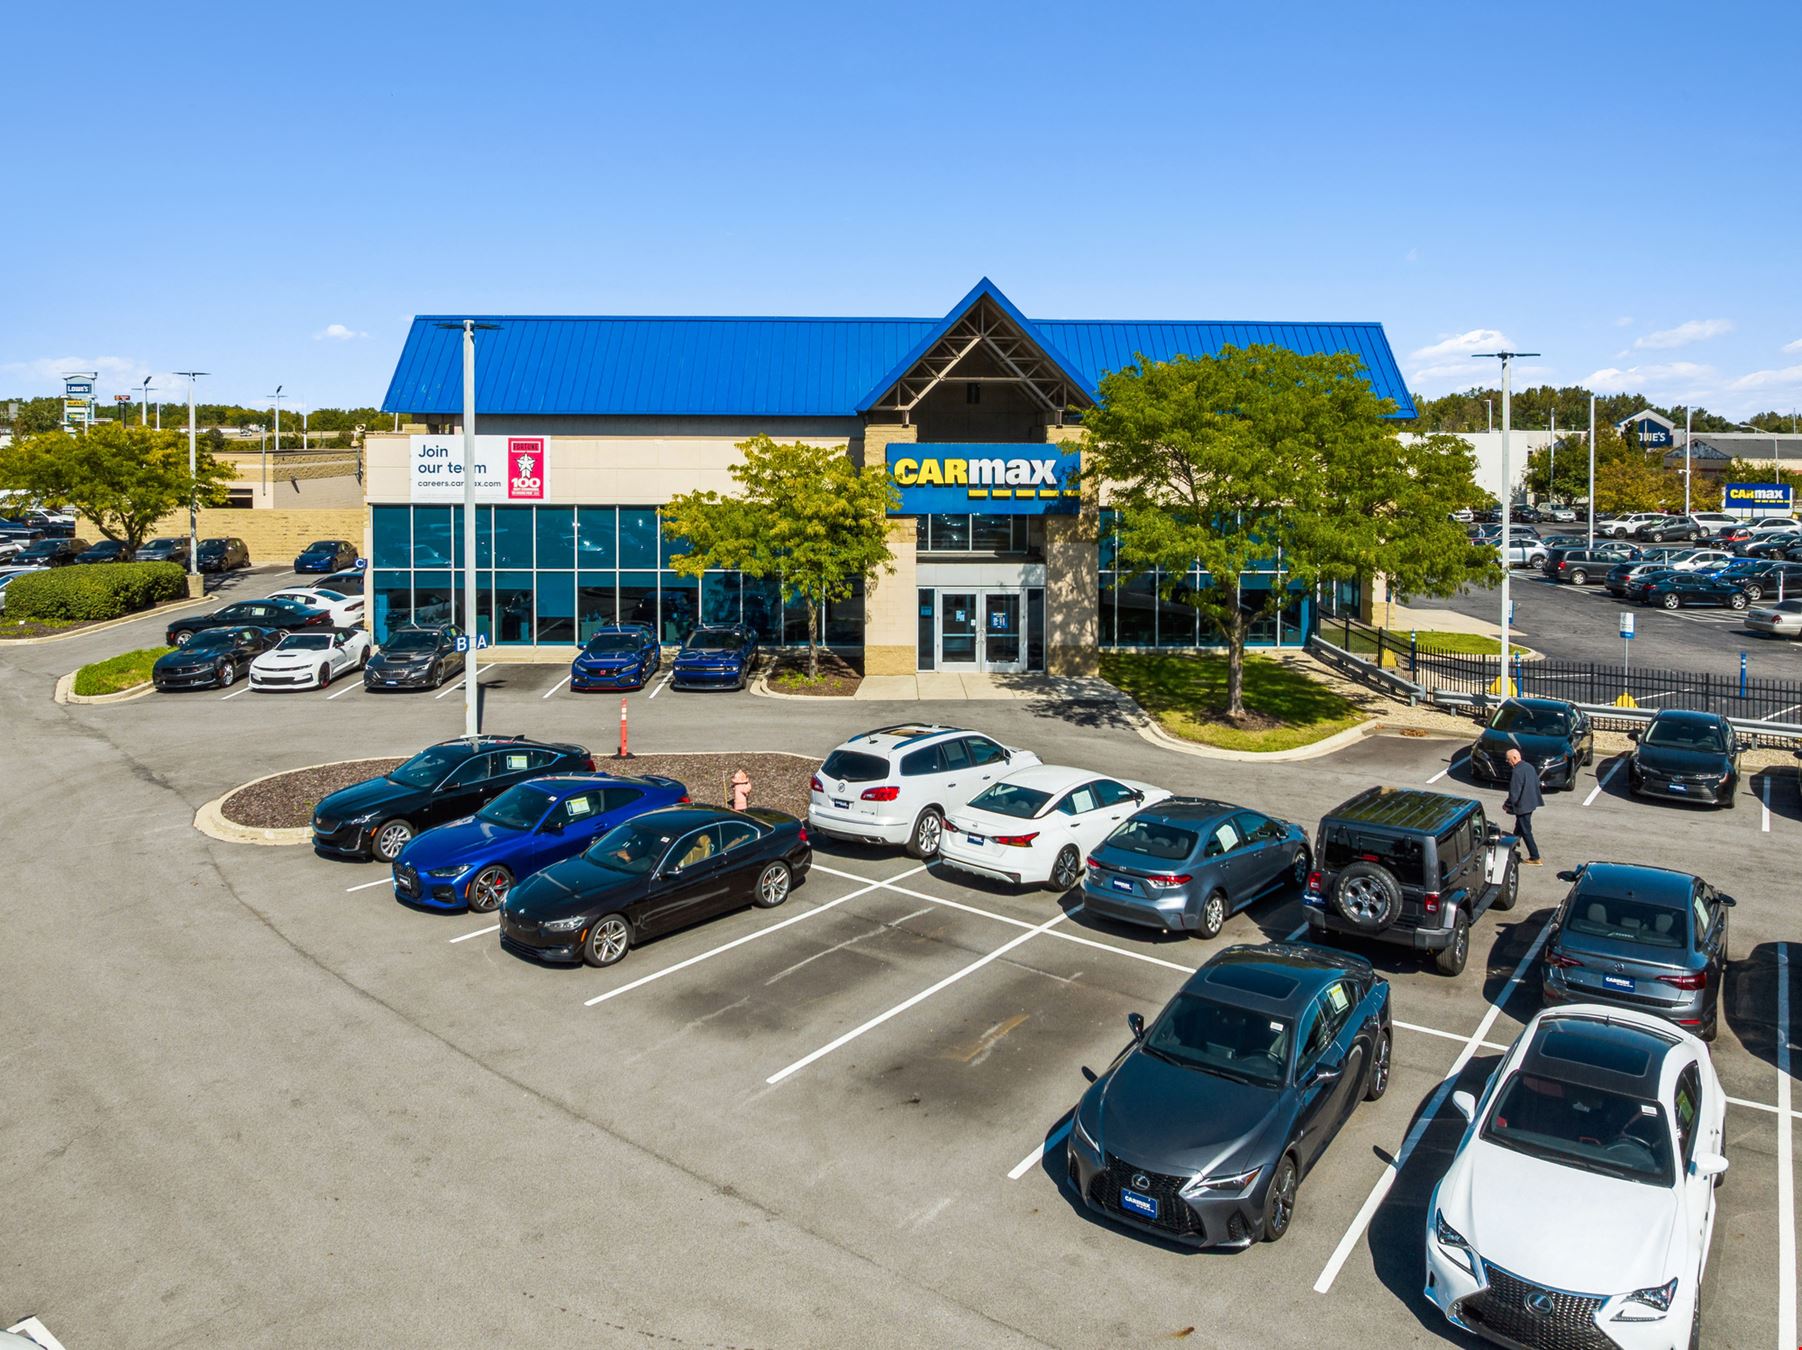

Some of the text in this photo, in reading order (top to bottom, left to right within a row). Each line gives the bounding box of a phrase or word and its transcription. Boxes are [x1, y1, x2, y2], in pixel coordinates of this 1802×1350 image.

[418, 444, 448, 458] Join
[418, 462, 487, 474] our tem
[511, 477, 541, 488] 100
[456, 637, 467, 652] B
[476, 634, 487, 649] A
